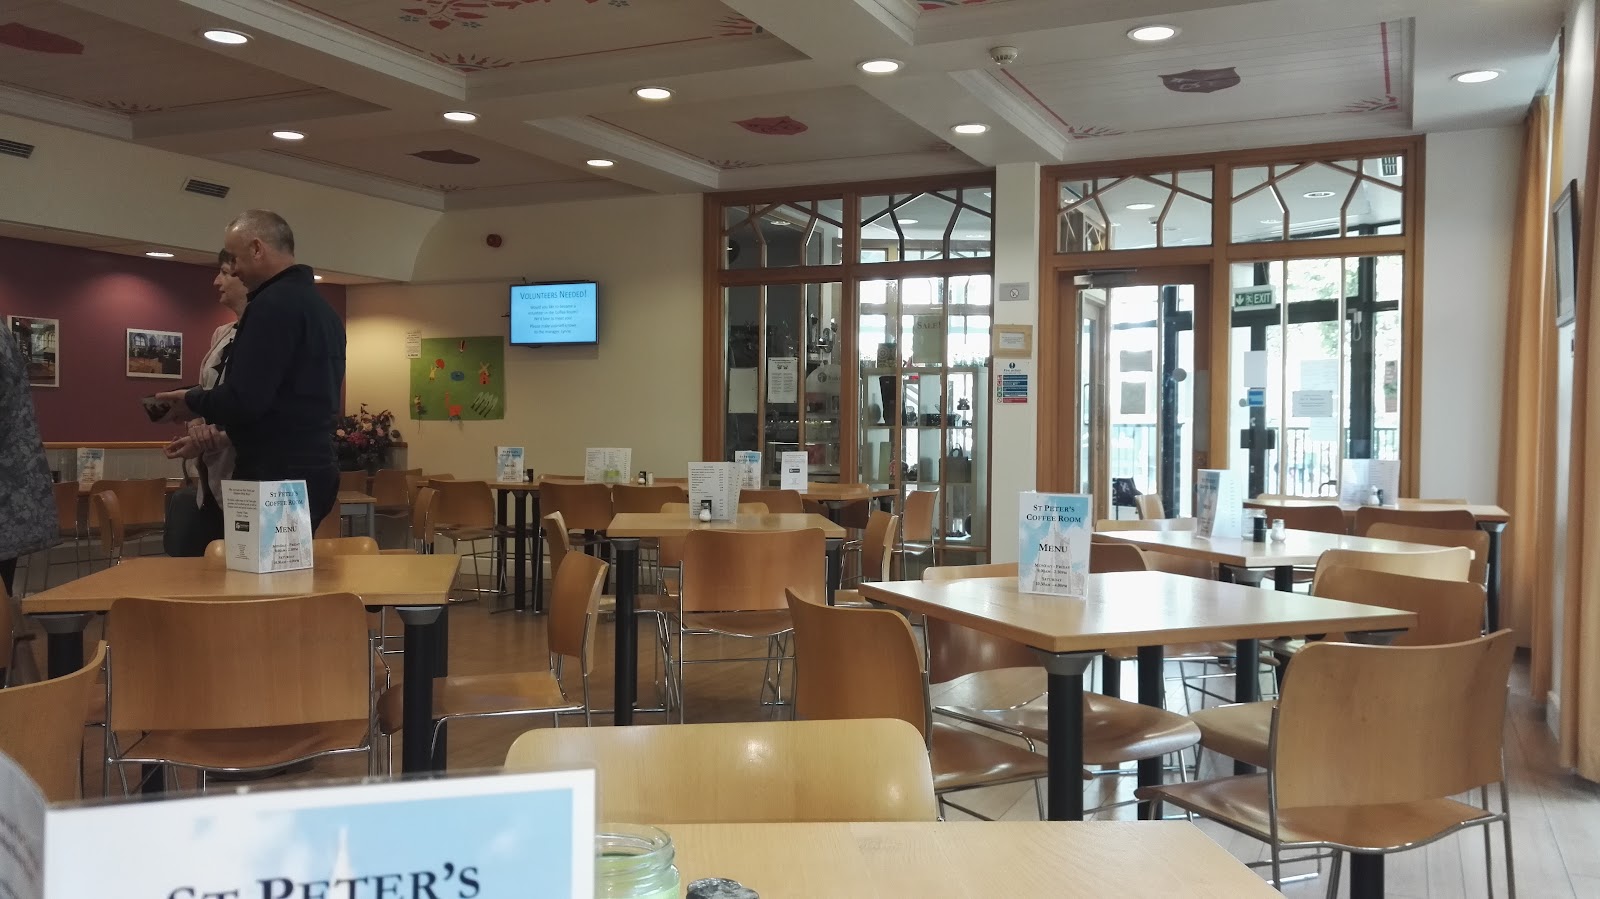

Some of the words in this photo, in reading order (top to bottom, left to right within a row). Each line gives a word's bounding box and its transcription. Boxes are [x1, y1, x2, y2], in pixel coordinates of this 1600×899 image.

[520, 292, 558, 300] VOLUNTEERS
[559, 290, 587, 298] NEEDED!
[1254, 293, 1271, 304] EXIT
[1033, 504, 1042, 512] ST
[1044, 504, 1075, 513] PETER'S
[1026, 513, 1056, 522] COFFEE
[1058, 515, 1081, 523] ROOM
[275, 525, 297, 534] MENU
[1038, 543, 1067, 552] MENU
[256, 862, 481, 899] PETER'S
